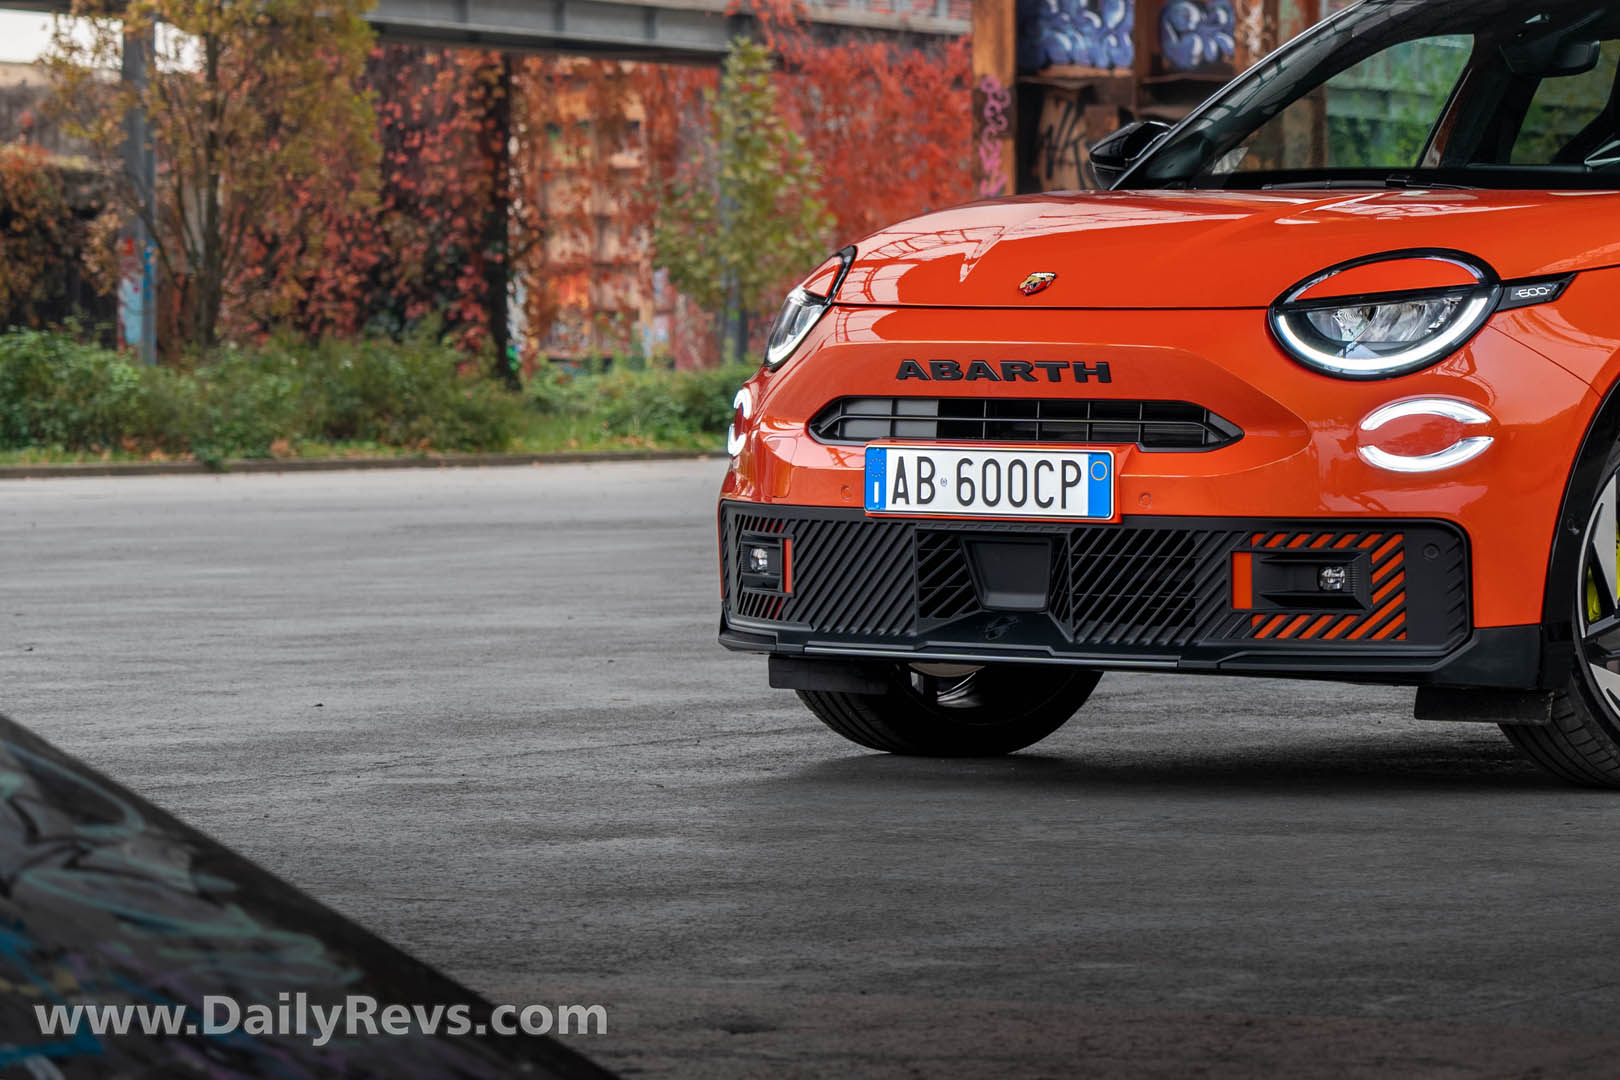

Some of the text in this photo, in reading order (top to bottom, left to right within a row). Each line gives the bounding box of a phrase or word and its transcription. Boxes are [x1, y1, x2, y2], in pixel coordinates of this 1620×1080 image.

[1516, 286, 1549, 298] 600
[896, 359, 1112, 383] ABARTH
[891, 455, 1082, 509] AB 600CP
